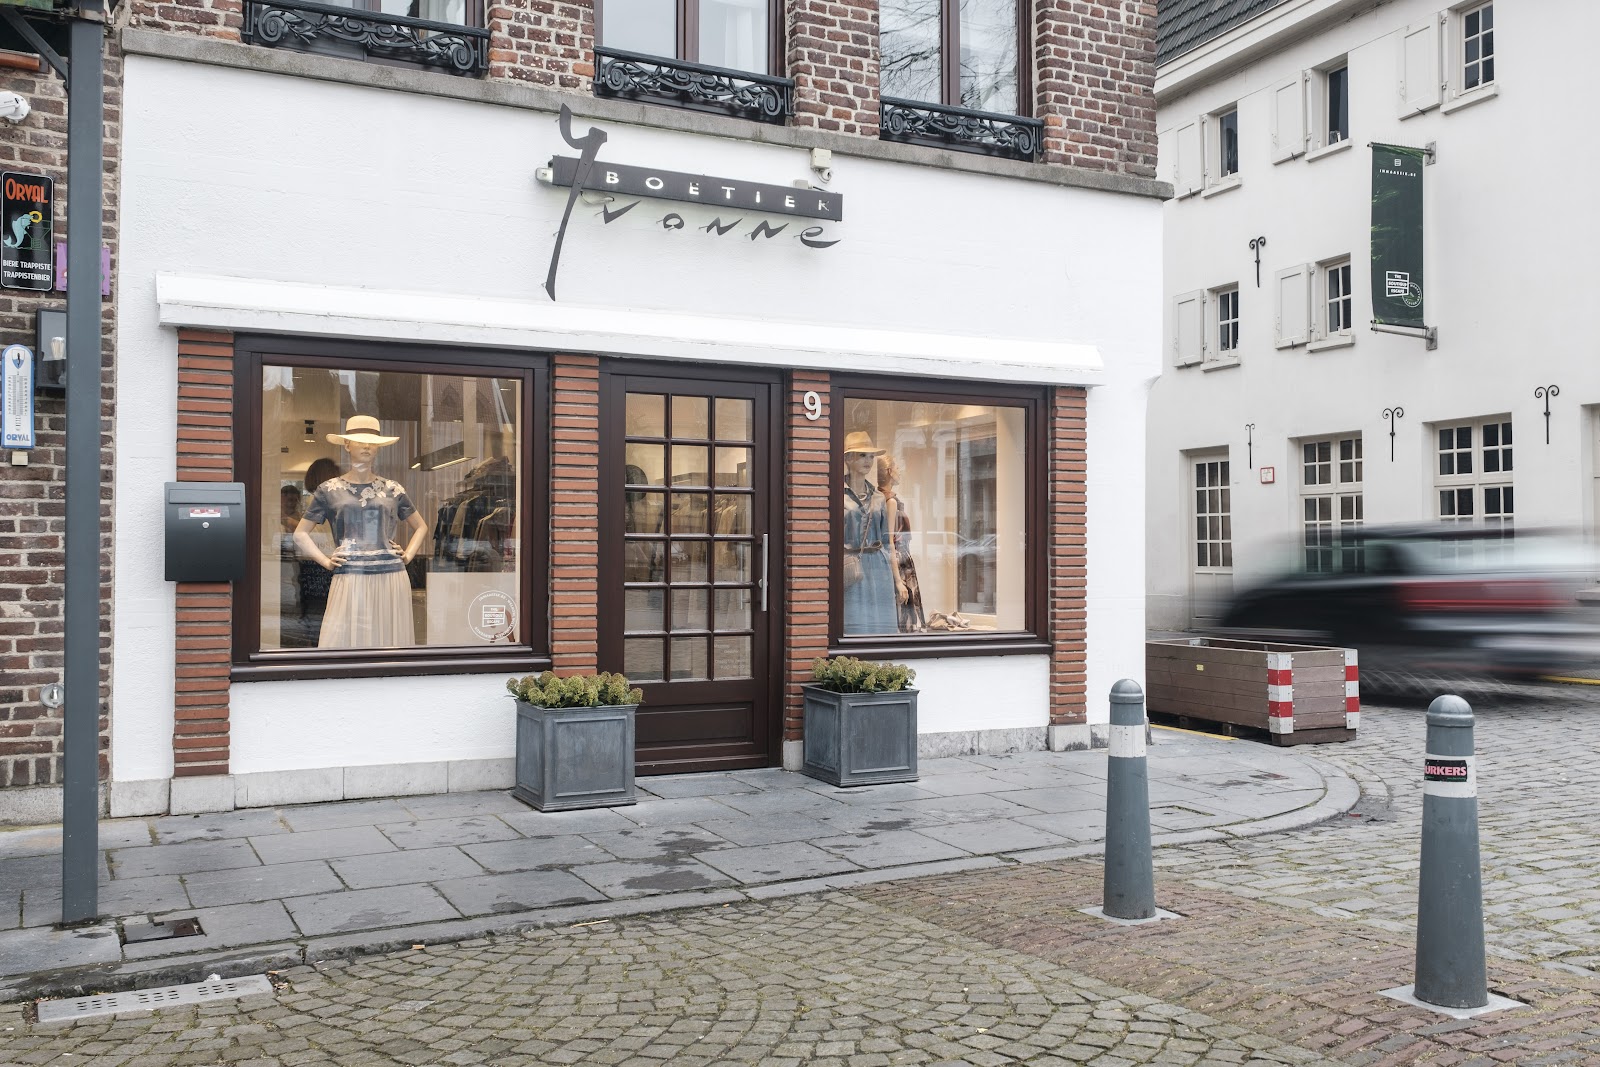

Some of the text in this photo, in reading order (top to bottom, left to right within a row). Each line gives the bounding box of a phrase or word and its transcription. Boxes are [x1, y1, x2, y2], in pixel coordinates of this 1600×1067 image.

[5, 178, 49, 203] ORVAL
[3, 260, 51, 271] BIERE TRAPPISTE
[4, 271, 51, 281] TRAPPISTENBIER
[803, 391, 822, 421] 9
